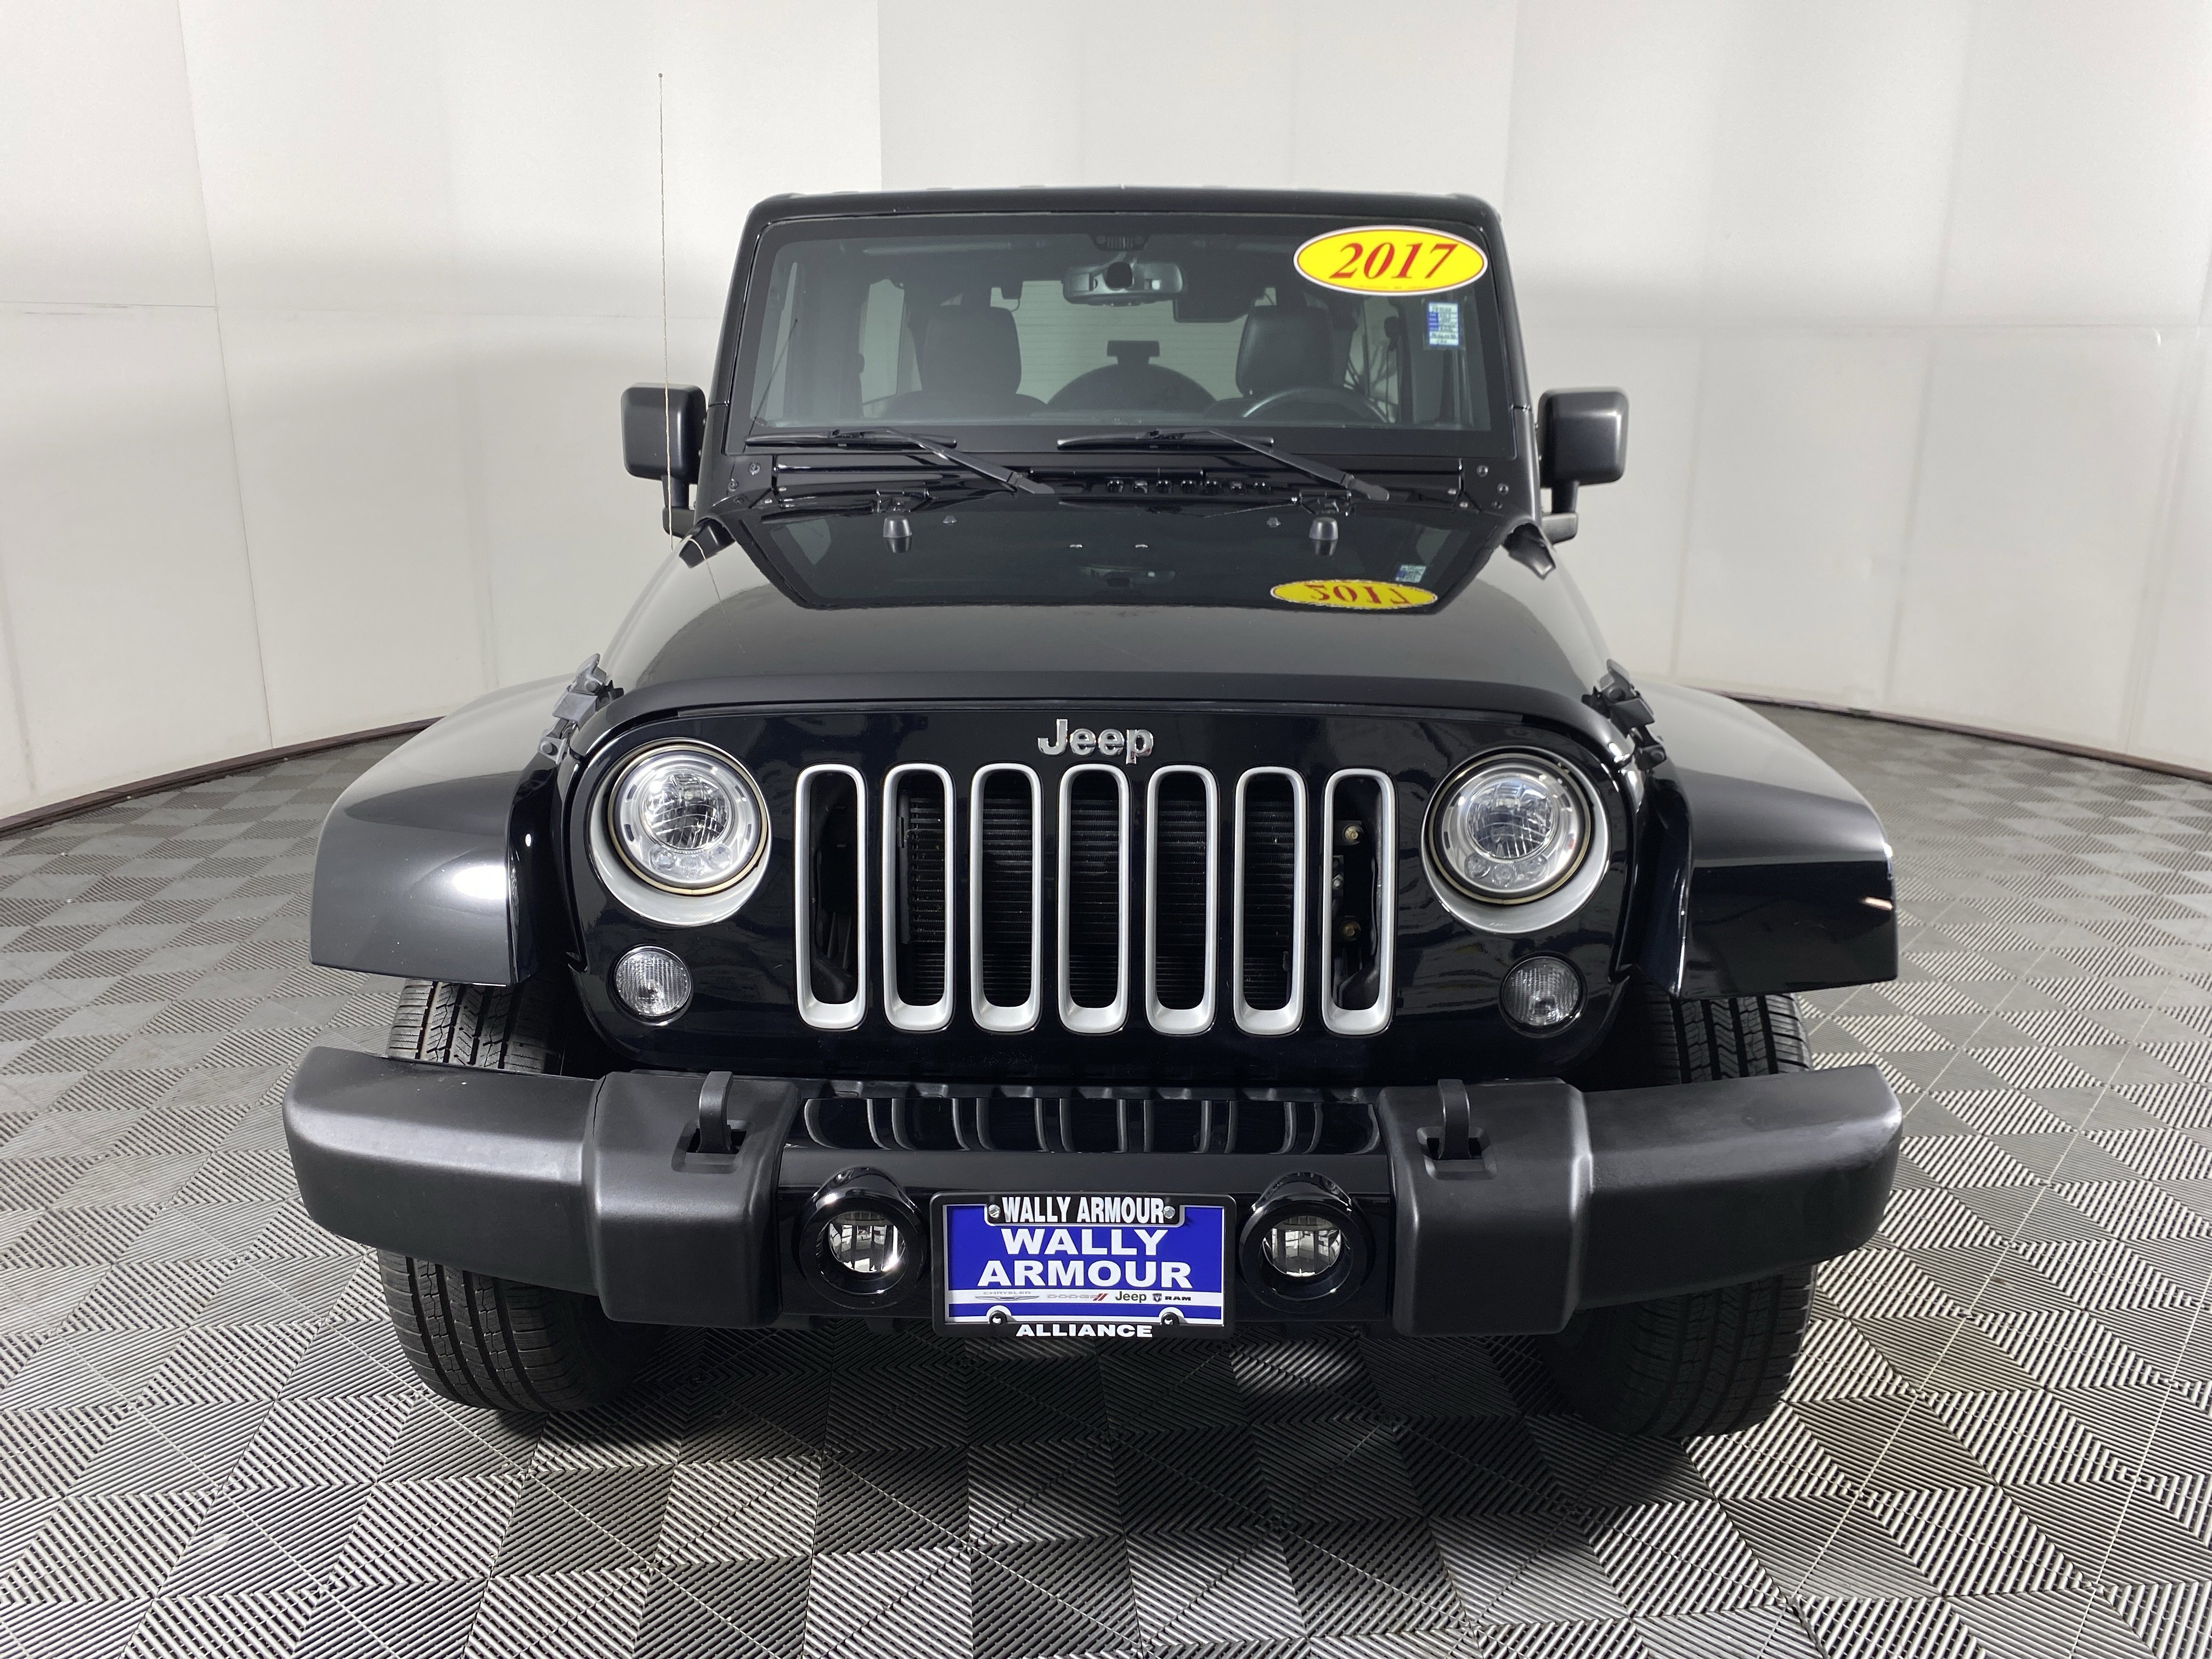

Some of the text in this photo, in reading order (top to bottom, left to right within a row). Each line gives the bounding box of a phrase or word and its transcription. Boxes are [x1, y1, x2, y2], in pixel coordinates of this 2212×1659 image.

[1329, 242, 1458, 279] 2017
[1037, 719, 1154, 765] Jeep
[1002, 1197, 1164, 1224] WALLY ARMOUR
[1001, 1228, 1169, 1256] WALLY
[977, 1260, 1193, 1288] ARMOUR
[1115, 1291, 1147, 1303] Jeep
[1015, 1324, 1153, 1338] ALLIANCE
